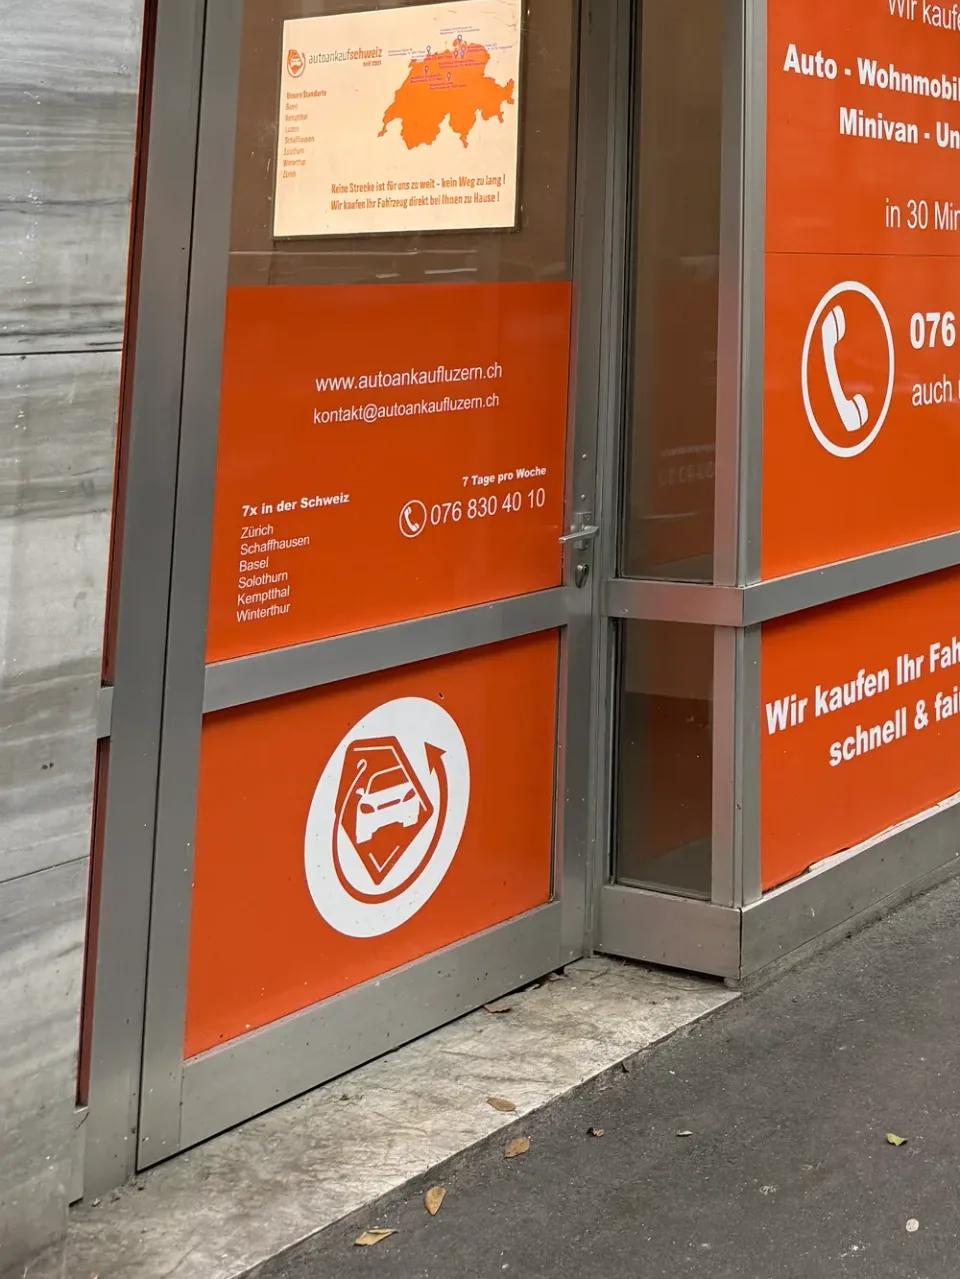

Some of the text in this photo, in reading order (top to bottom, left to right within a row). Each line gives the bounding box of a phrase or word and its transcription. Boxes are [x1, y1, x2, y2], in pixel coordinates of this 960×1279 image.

[783, 43, 838, 80] Auto
[839, 106, 919, 144] Minivan
[331, 183, 348, 193] Keine
[349, 182, 375, 193] Strecke
[376, 182, 385, 191] ist
[387, 180, 397, 191] für
[420, 178, 435, 189] weit
[441, 177, 457, 188] kein
[459, 176, 475, 188] Weg
[476, 177, 484, 186] zu
[485, 175, 501, 187] lang
[331, 200, 342, 210] Wir
[343, 199, 365, 210] kaufen
[377, 197, 407, 209] Fahrzeug
[408, 195, 429, 206] direkt
[430, 195, 440, 205] bei
[442, 193, 463, 204] Ihnen
[464, 195, 472, 204] zu
[473, 192, 495, 203] Hause
[885, 197, 900, 228] in
[906, 198, 929, 230] 30
[909, 311, 956, 349] 076
[315, 361, 503, 392] www.autoankaufluzern.ch
[911, 373, 952, 407] auch
[313, 393, 500, 424] kontakt@autoankaufluzern.ch
[462, 466, 547, 487] 7 Tage pro Woche
[241, 491, 350, 518] 7x in der Schweiz
[430, 487, 546, 525] 076 830 40 10
[240, 535, 310, 556] Schaffhausen
[241, 524, 274, 540] Zürich
[239, 556, 269, 572] Basel
[238, 570, 288, 589] Solothurn
[237, 585, 290, 606] Kemptthal
[236, 602, 291, 623] Winterthur
[765, 694, 808, 735] Wir
[814, 668, 890, 718] kaufen
[896, 652, 924, 686] Ihr
[829, 706, 907, 767] schnell
[913, 699, 929, 730] &
